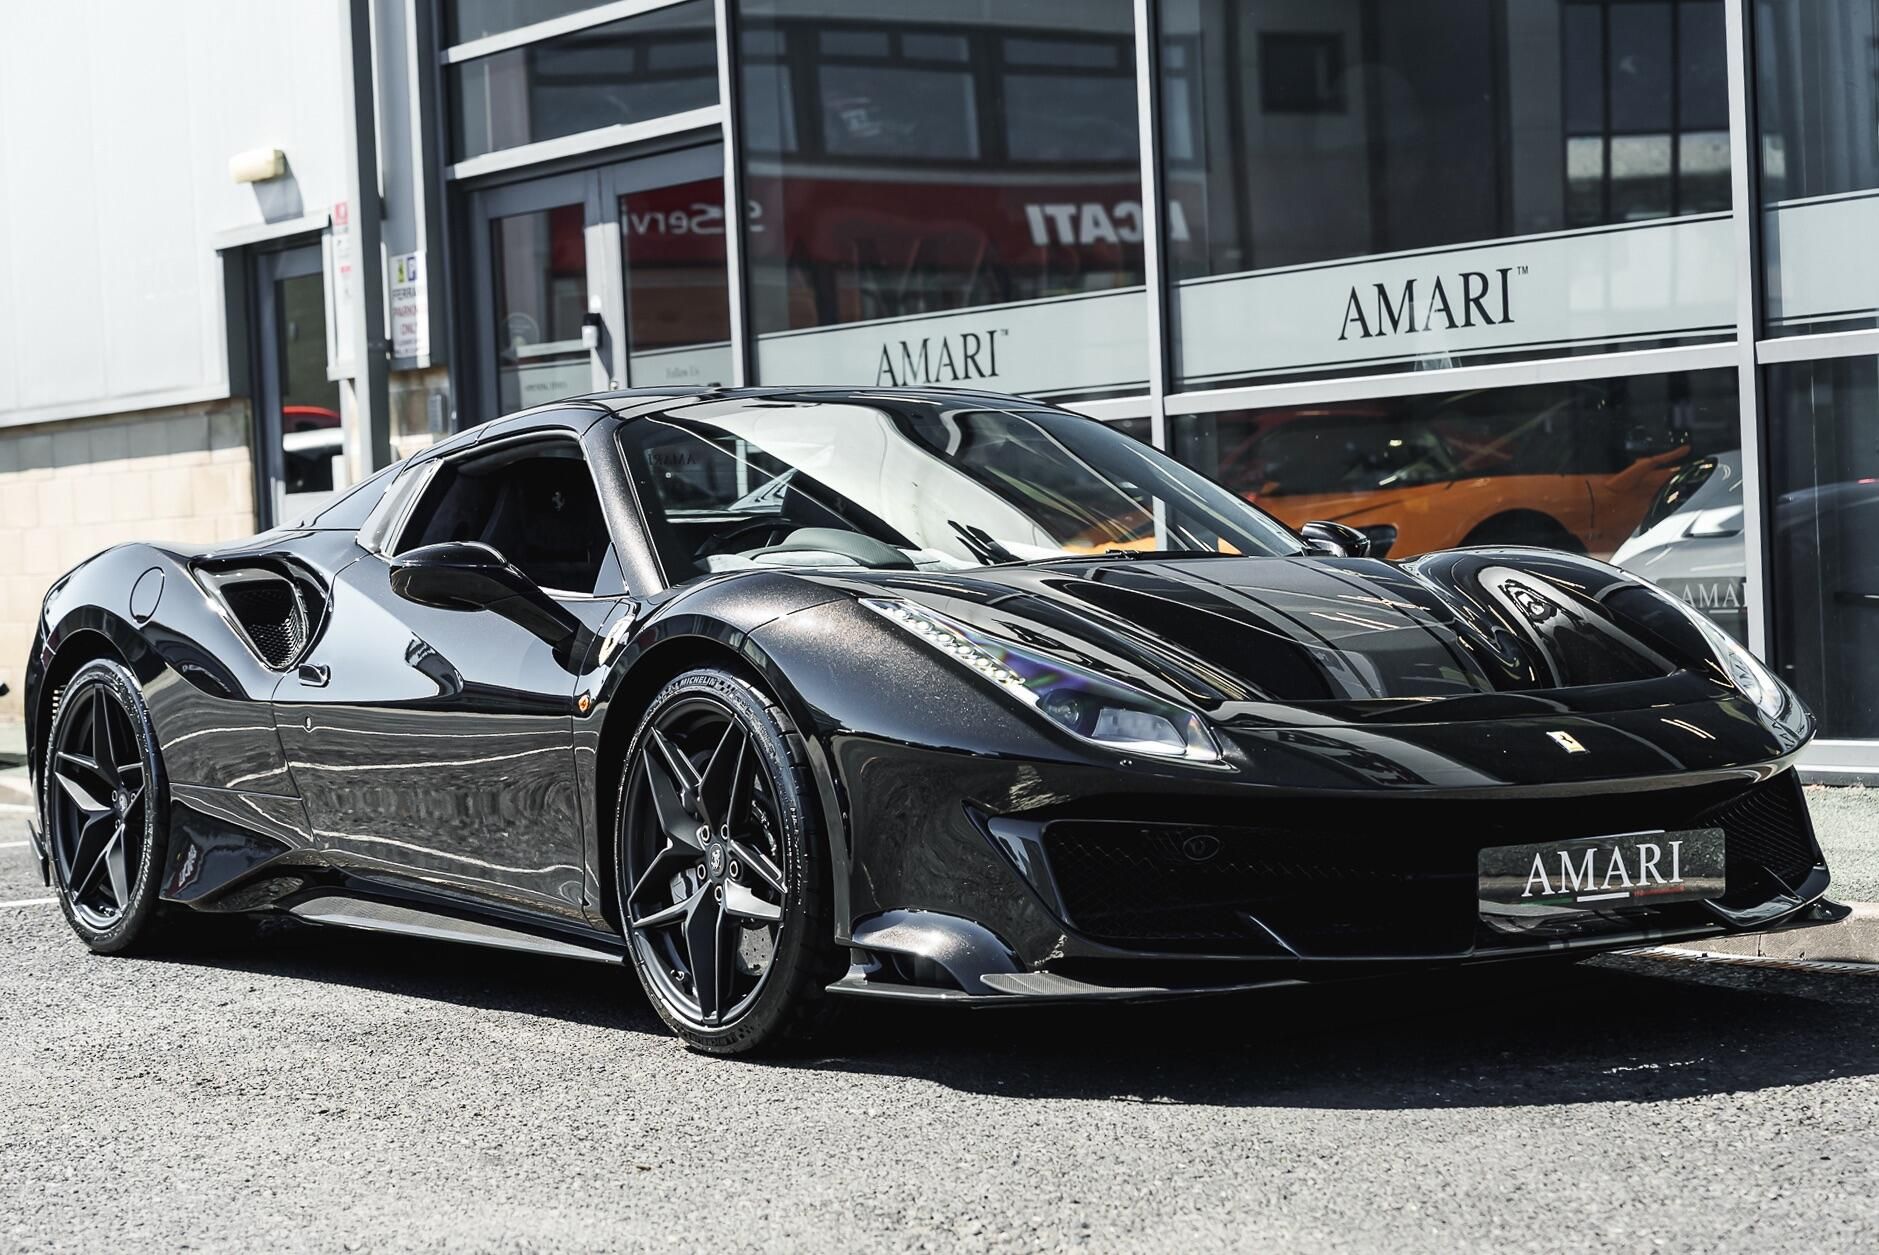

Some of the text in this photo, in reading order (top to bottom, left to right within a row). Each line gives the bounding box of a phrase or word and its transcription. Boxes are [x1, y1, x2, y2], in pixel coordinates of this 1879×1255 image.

[1338, 268, 1515, 340] AMARI
[876, 330, 999, 387] AMARI
[680, 675, 718, 688] MICHELIN
[1521, 840, 1684, 898] AMARI
